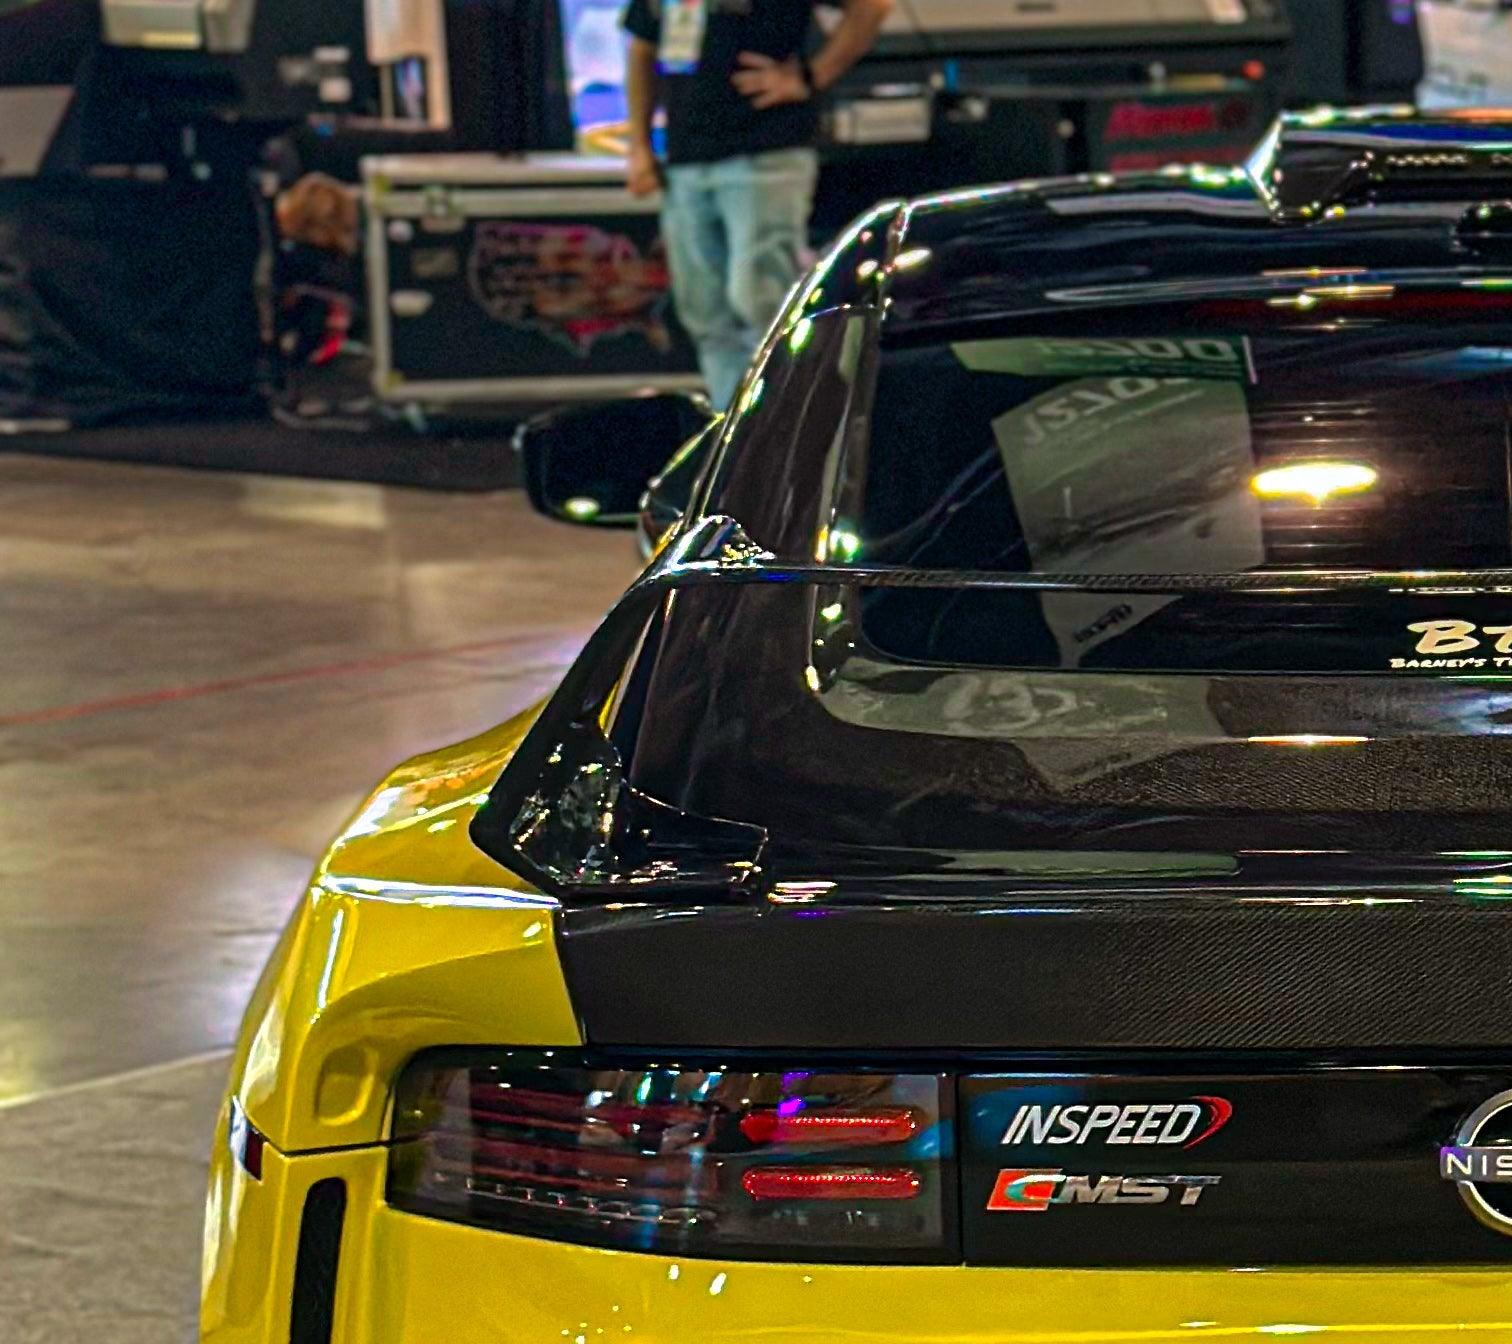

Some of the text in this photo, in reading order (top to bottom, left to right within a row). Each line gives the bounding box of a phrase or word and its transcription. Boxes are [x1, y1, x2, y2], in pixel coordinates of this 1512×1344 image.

[1388, 657, 1487, 668] BARNEY'S
[1000, 1103, 1202, 1145] INSPEED
[998, 1171, 1222, 1208] CMST
